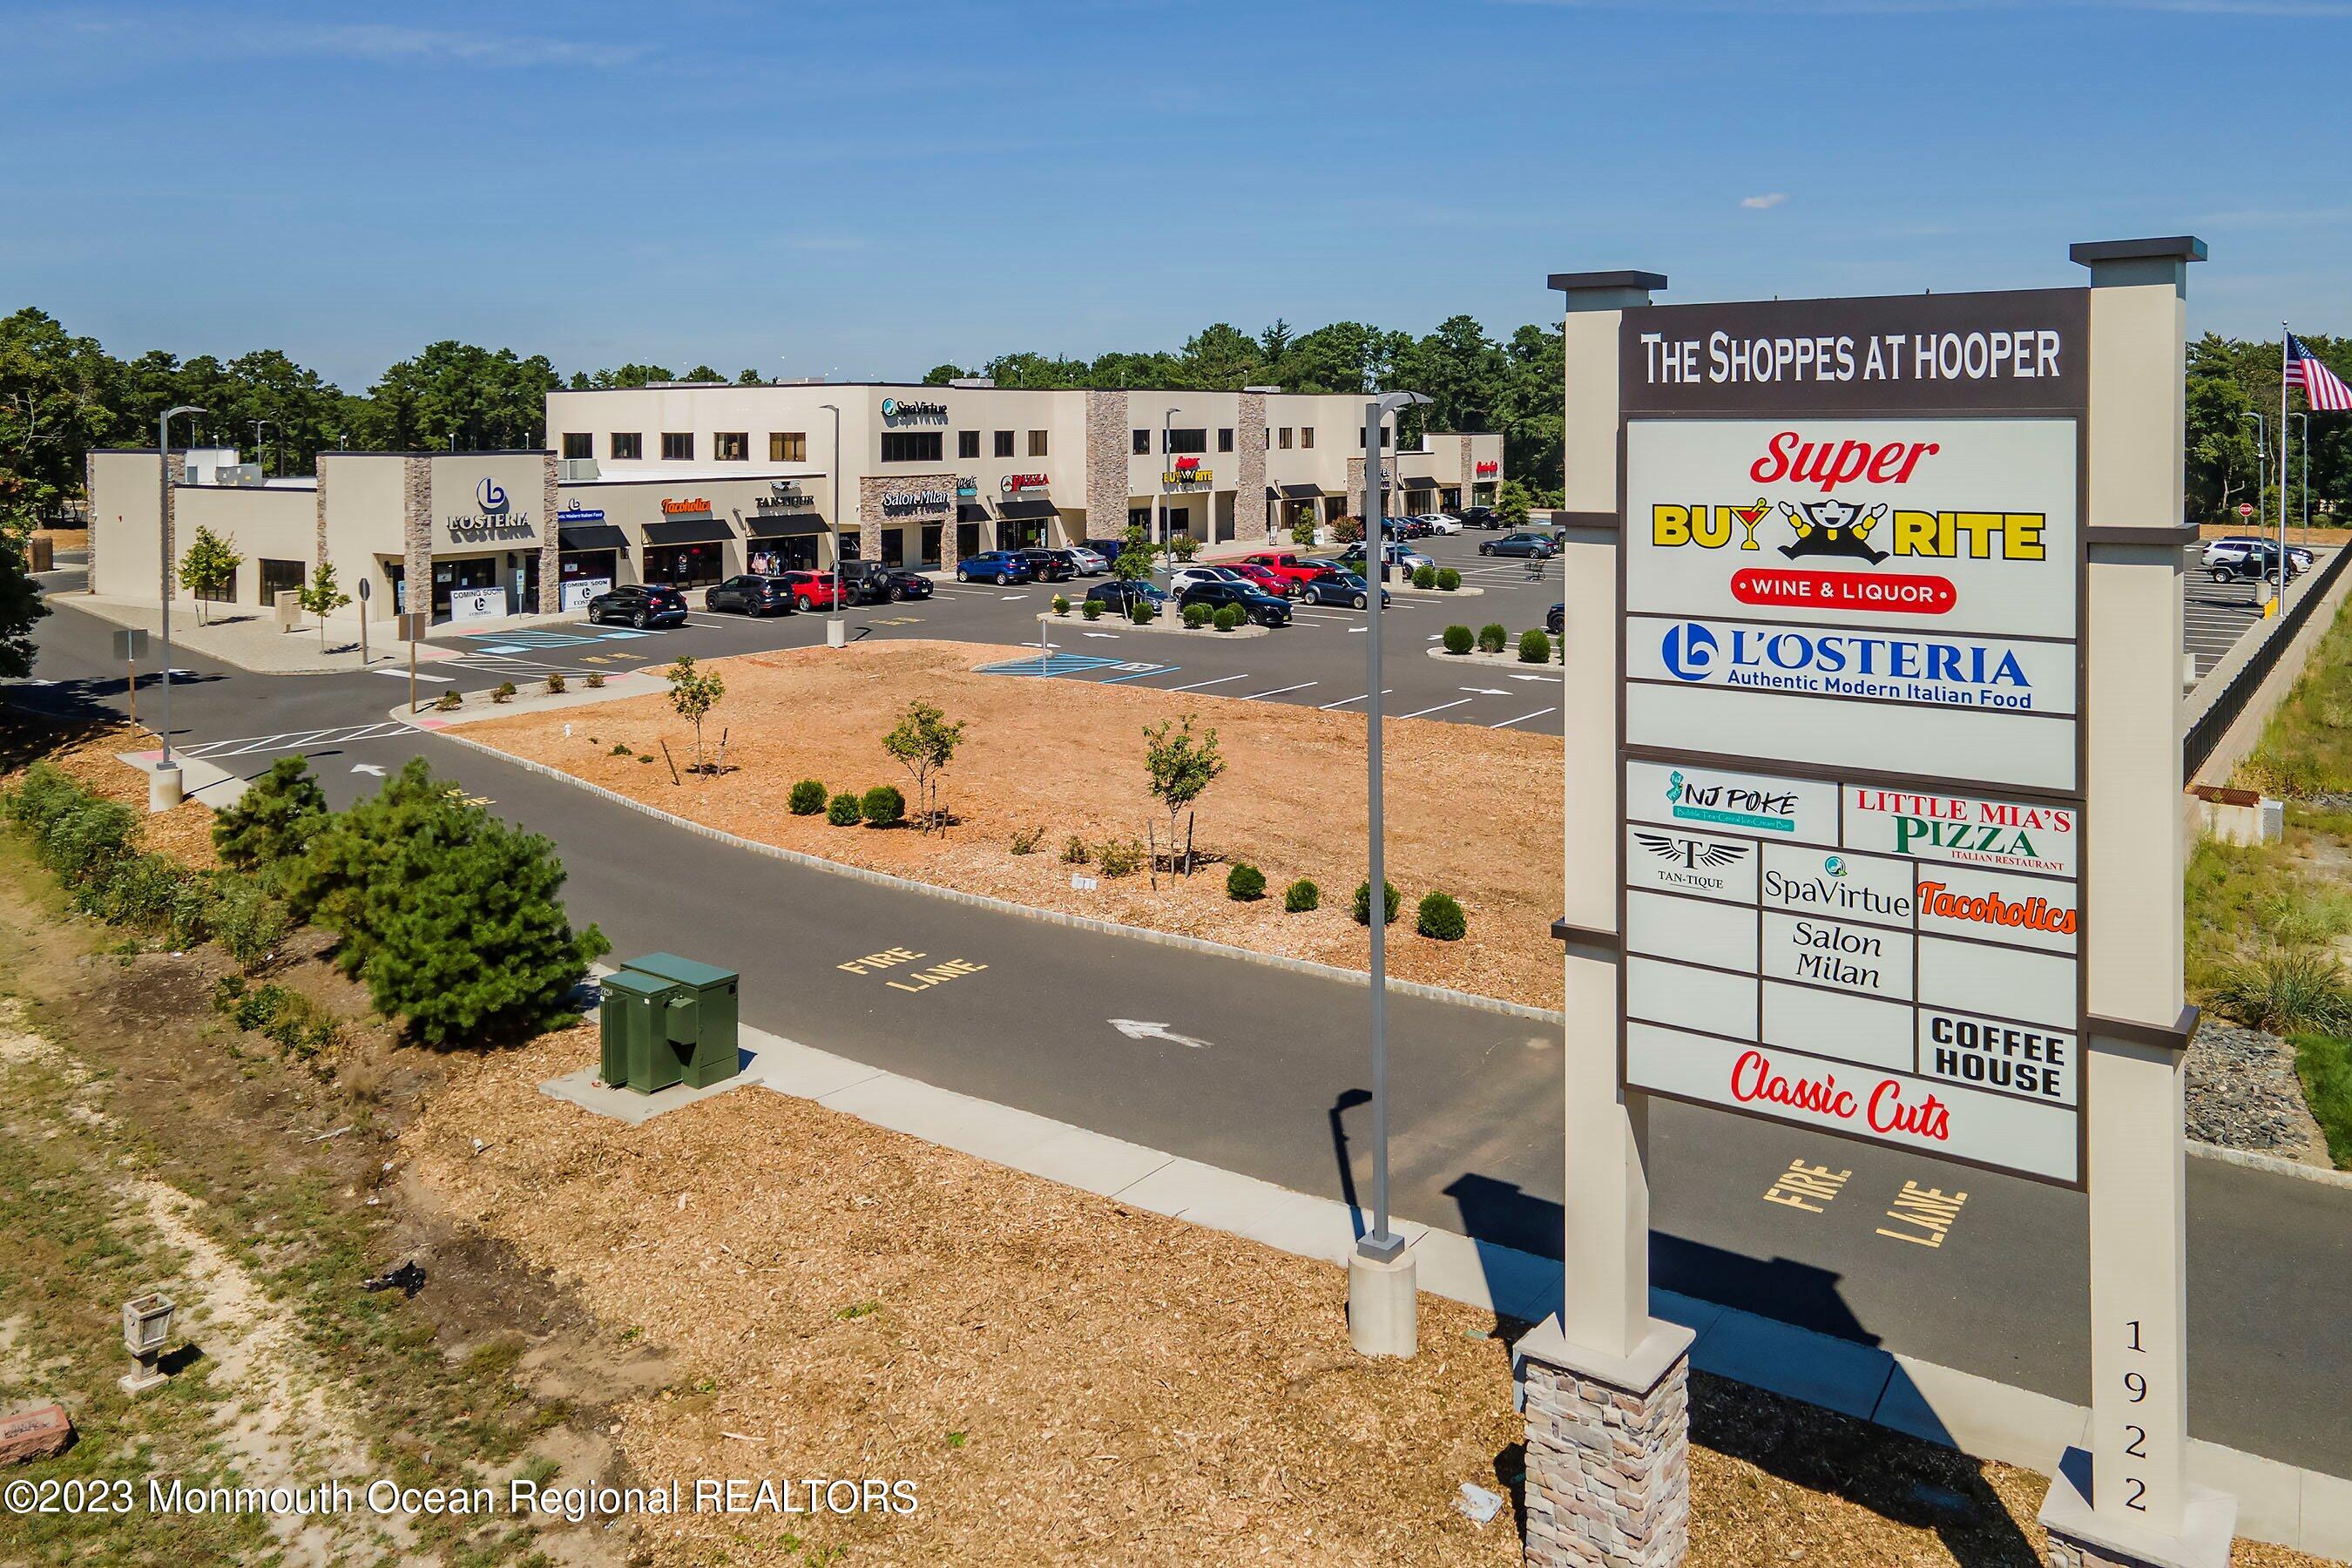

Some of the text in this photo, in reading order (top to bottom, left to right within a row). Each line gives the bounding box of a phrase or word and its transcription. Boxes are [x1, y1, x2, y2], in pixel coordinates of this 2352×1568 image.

[1640, 330, 2060, 383] THE SHOPPES AT HOOPER
[1012, 473, 1050, 492] PIZZA
[1749, 431, 1940, 492] Super
[661, 498, 711, 514] Tacoholics
[883, 493, 917, 506] Salon
[920, 490, 950, 504] Milan
[1652, 497, 2046, 561] BUY RITE
[1751, 578, 1934, 604] WINE & LIQUOR
[1730, 630, 2033, 687] L'OSTERIA
[1727, 669, 2032, 709] Authentic Modern Italian Food
[1686, 784, 1723, 806] NJ
[1856, 789, 2071, 834] LITTLE MIA'S
[1891, 814, 2039, 857] PIZZA
[1658, 870, 1724, 889] TAN-TIQUE
[1951, 850, 2064, 871] ITALIAN RESTAURANT
[1765, 869, 1910, 916] SpaVirtue
[1916, 880, 2078, 935] Tacoholics
[836, 947, 927, 976] FIRE
[1793, 922, 1882, 957] Salon
[885, 958, 989, 992] LANE
[1795, 954, 1881, 989] Milan
[1931, 1017, 2065, 1067] COFFEE
[1936, 1049, 2061, 1098] HOUSE
[1730, 1051, 1950, 1141] Classic Cuts
[1763, 1159, 1853, 1213] FIRE
[1876, 1179, 1968, 1248] LANE
[2123, 1321, 2147, 1512] 1922
